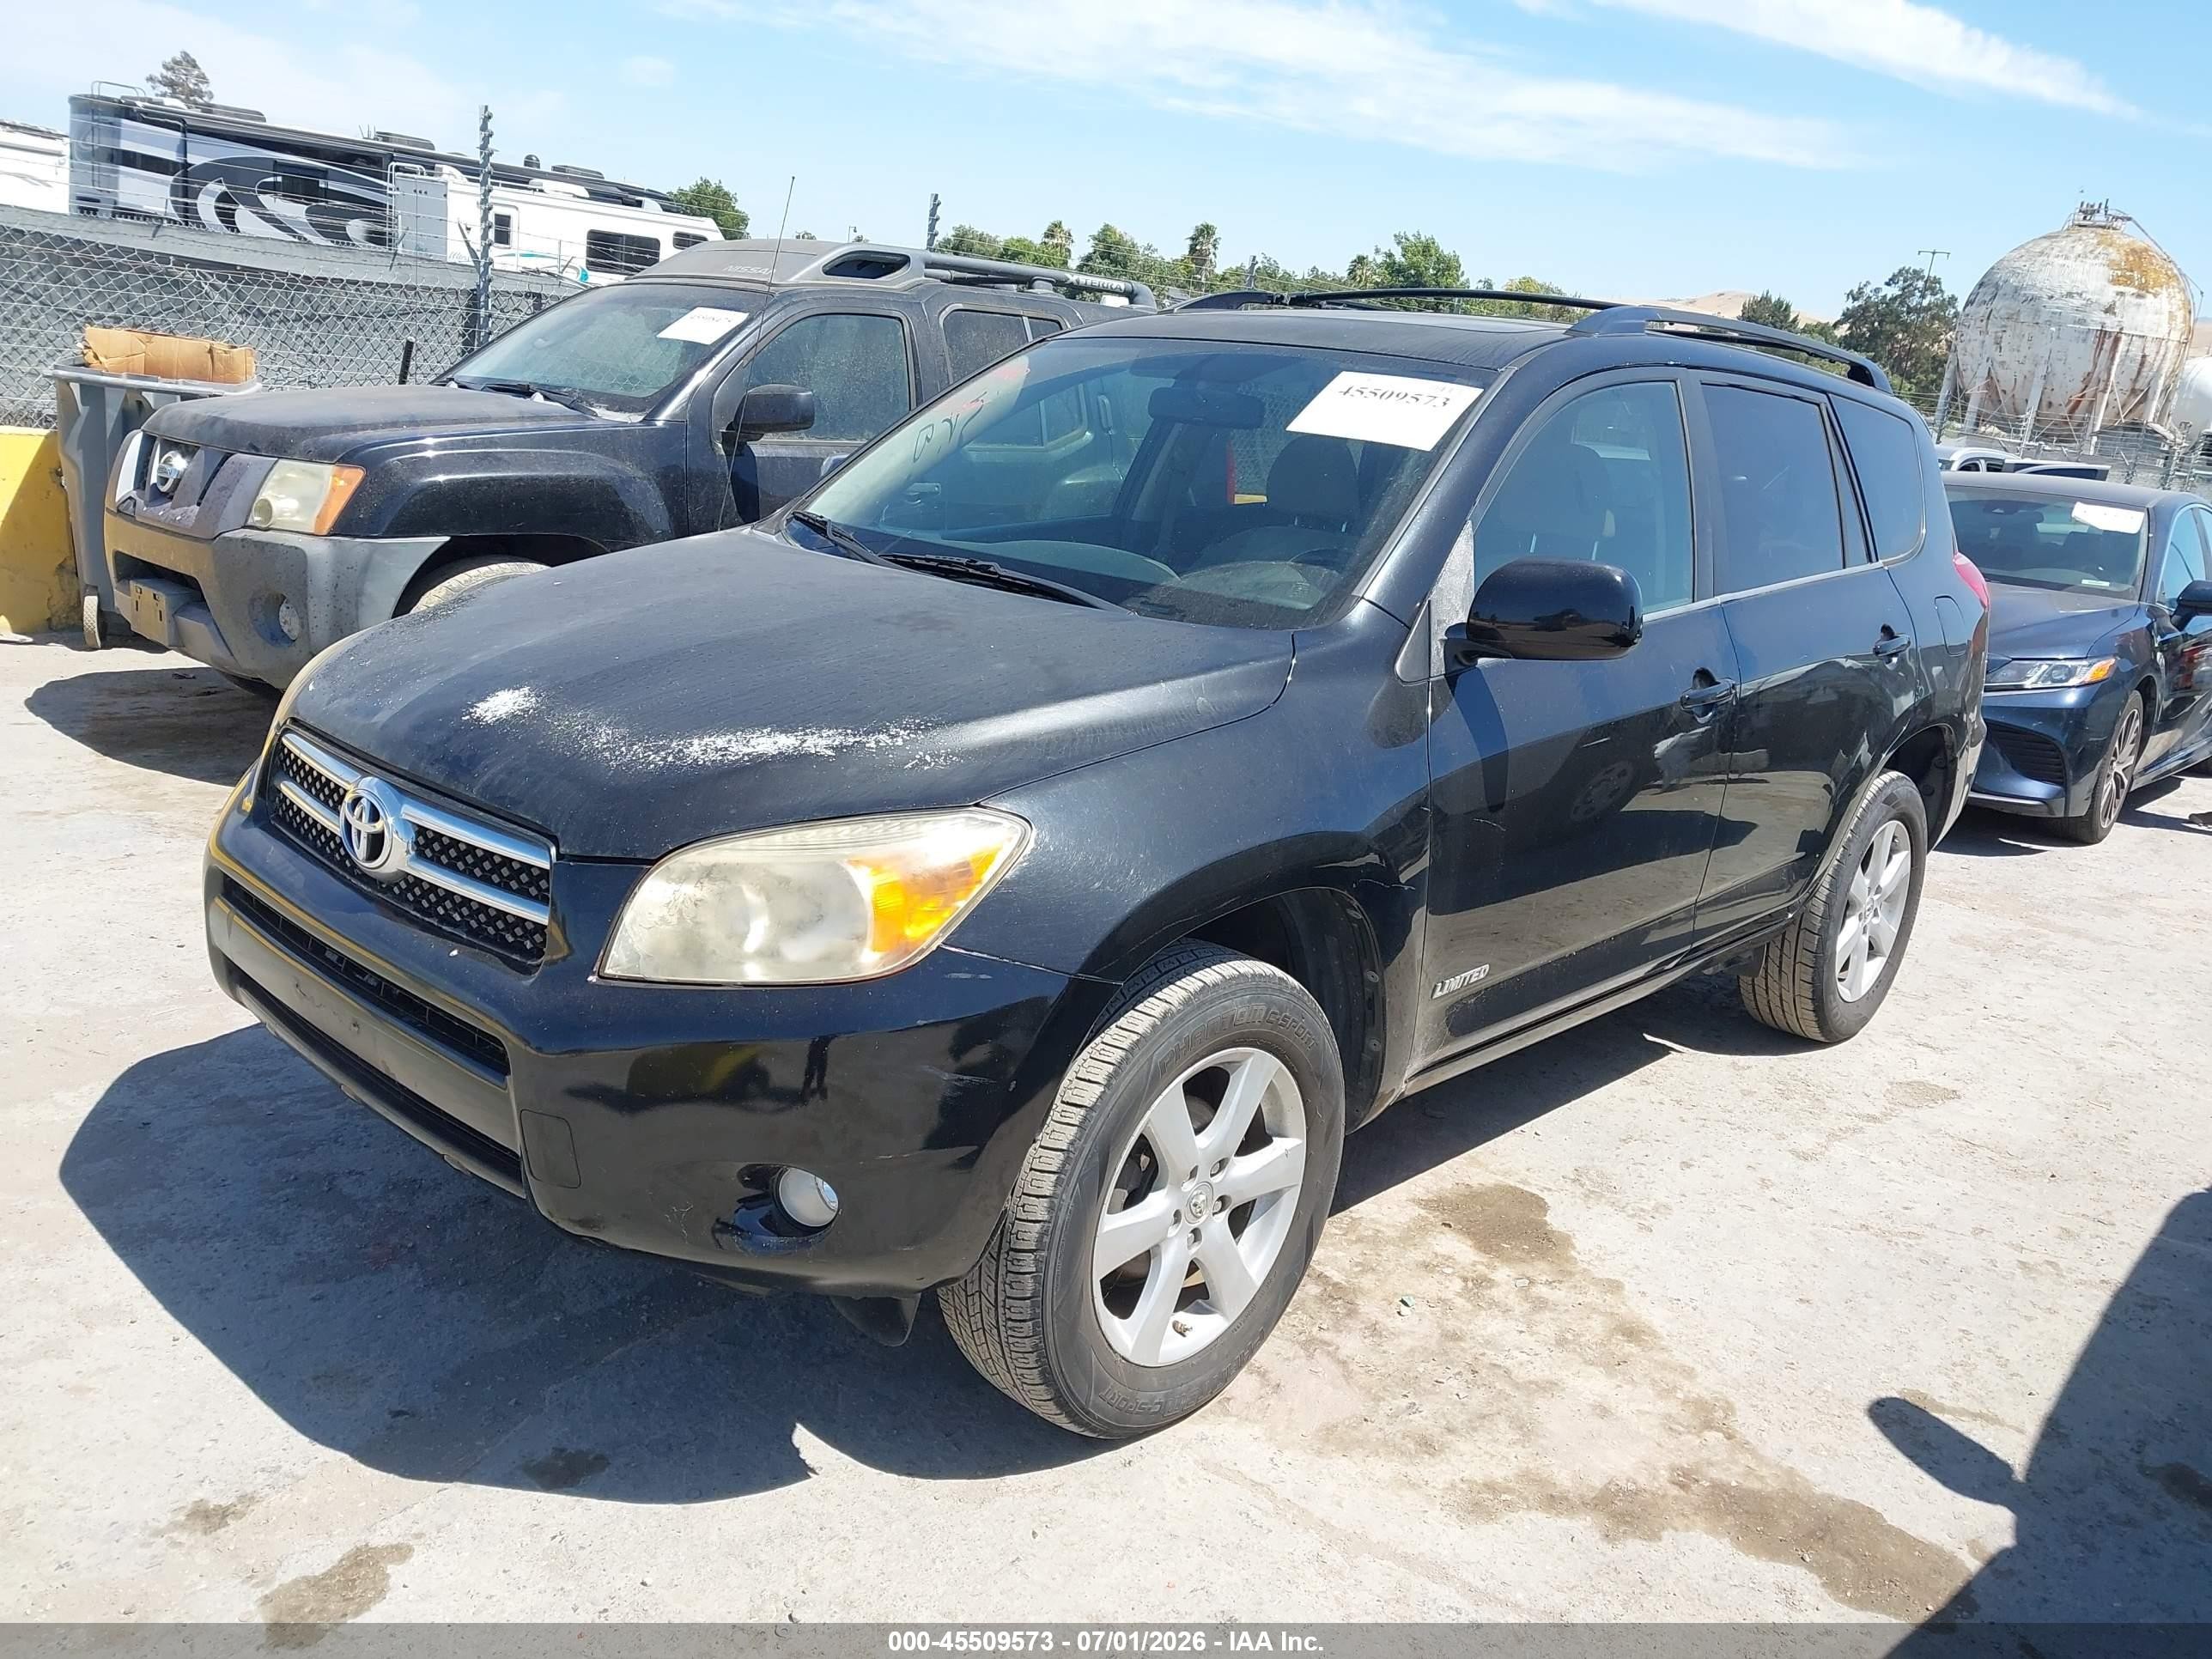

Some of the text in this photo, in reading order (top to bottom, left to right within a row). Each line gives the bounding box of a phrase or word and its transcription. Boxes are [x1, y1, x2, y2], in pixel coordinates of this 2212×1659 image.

[723, 264, 776, 275] NISSAN
[1065, 274, 1123, 292] XTERRA
[1339, 386, 1450, 408] 45509573
[1431, 963, 1490, 1000] LIMITED
[1159, 1003, 1266, 1079] PHANTOM
